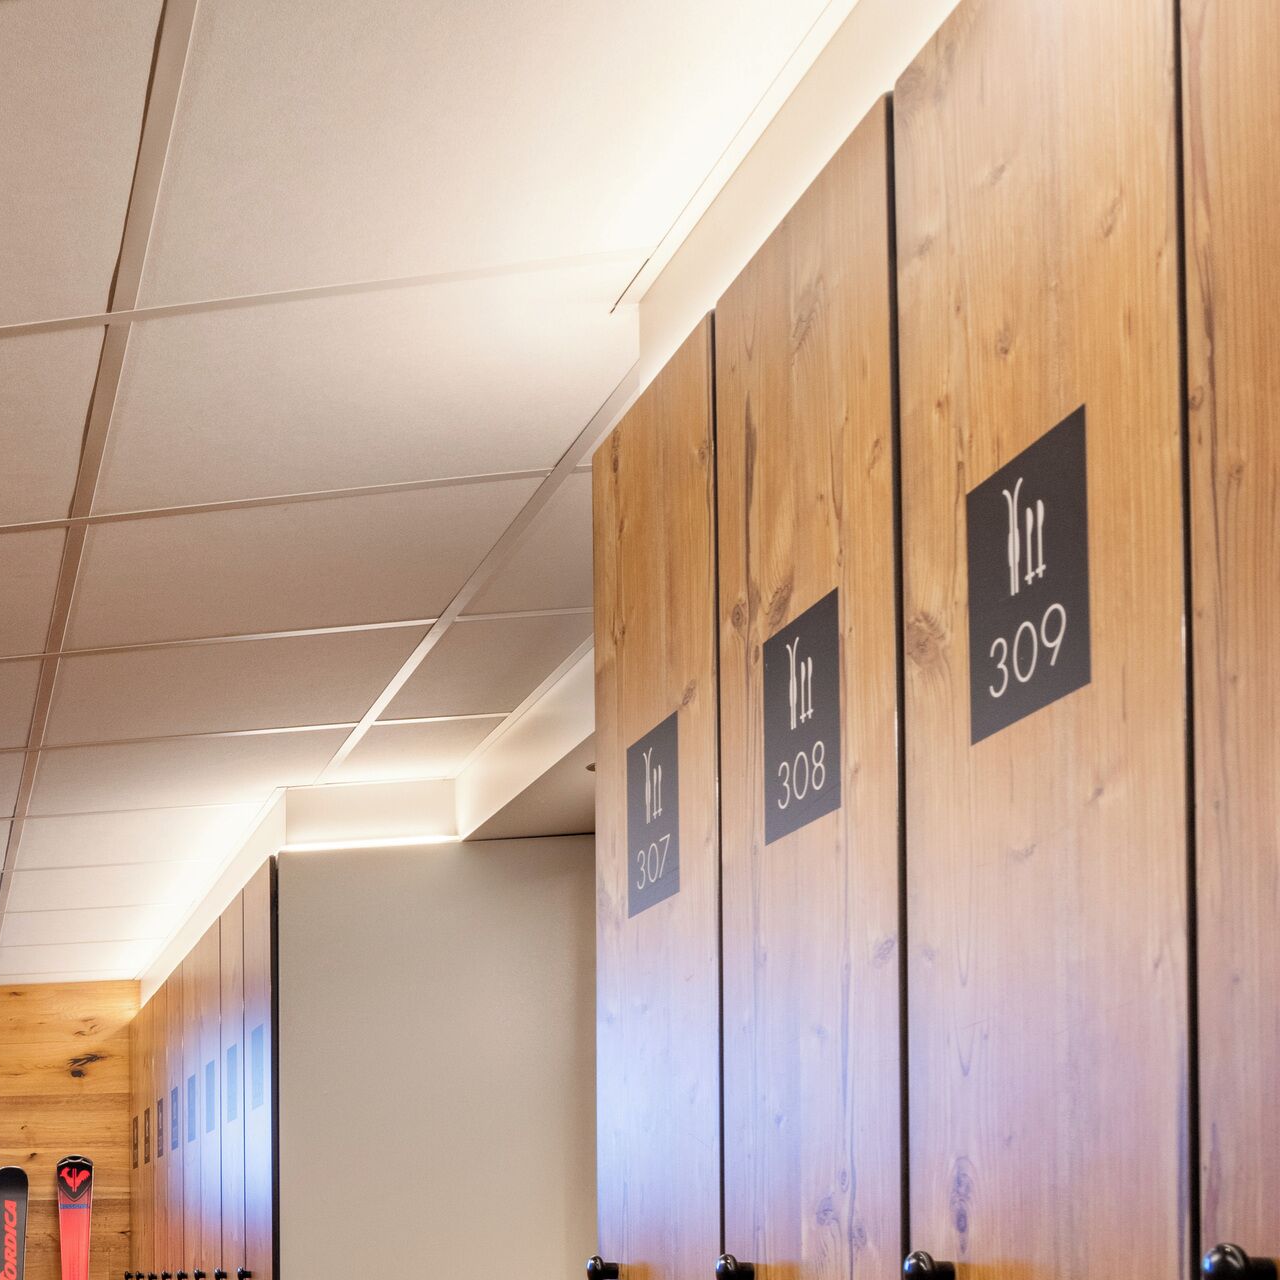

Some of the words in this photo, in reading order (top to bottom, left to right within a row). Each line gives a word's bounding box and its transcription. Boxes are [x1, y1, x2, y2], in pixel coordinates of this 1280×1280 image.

[988, 602, 1068, 699] 309
[777, 740, 826, 810] 308
[636, 833, 671, 890] 307
